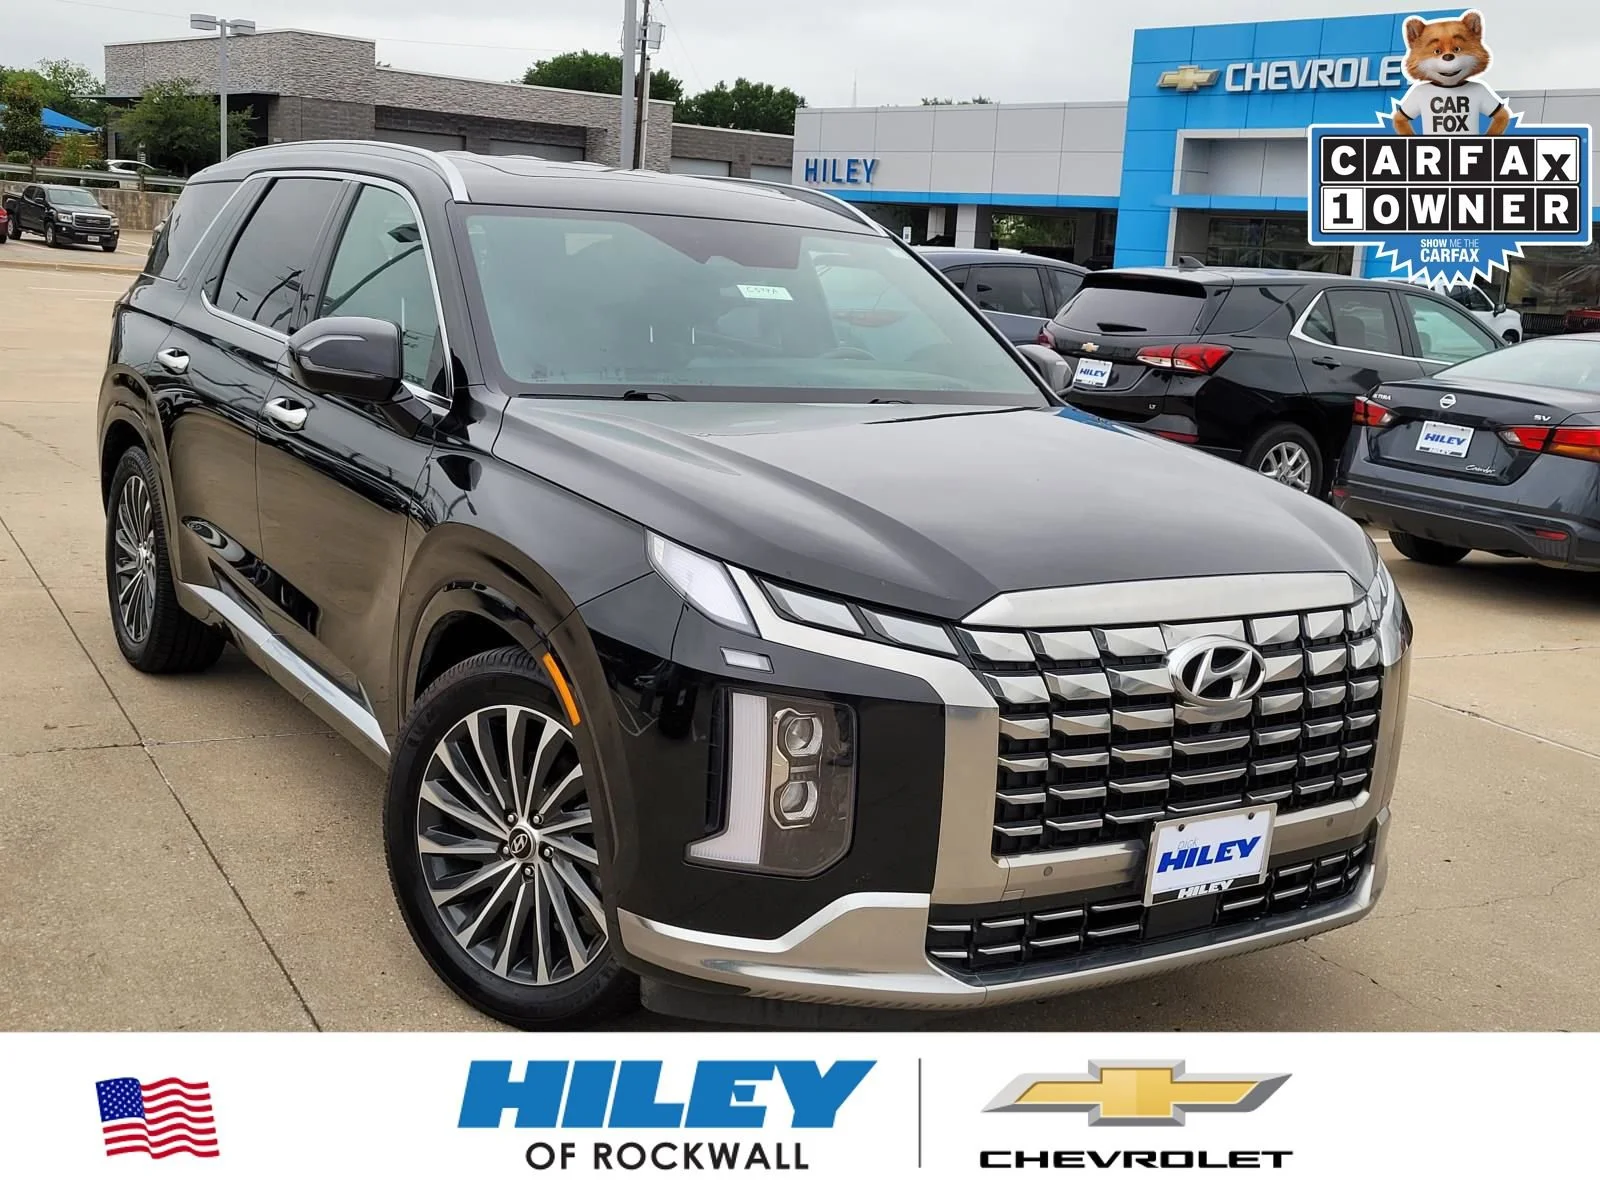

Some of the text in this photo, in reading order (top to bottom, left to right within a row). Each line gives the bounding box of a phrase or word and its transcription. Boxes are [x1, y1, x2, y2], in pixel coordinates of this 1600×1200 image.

[1225, 55, 1412, 92] CHEVROLE
[804, 158, 877, 184] HILEY
[1079, 367, 1107, 378] HILEY
[1424, 432, 1468, 446] HILEY
[1156, 836, 1262, 874] HILEY
[1177, 879, 1234, 900] HILEY
